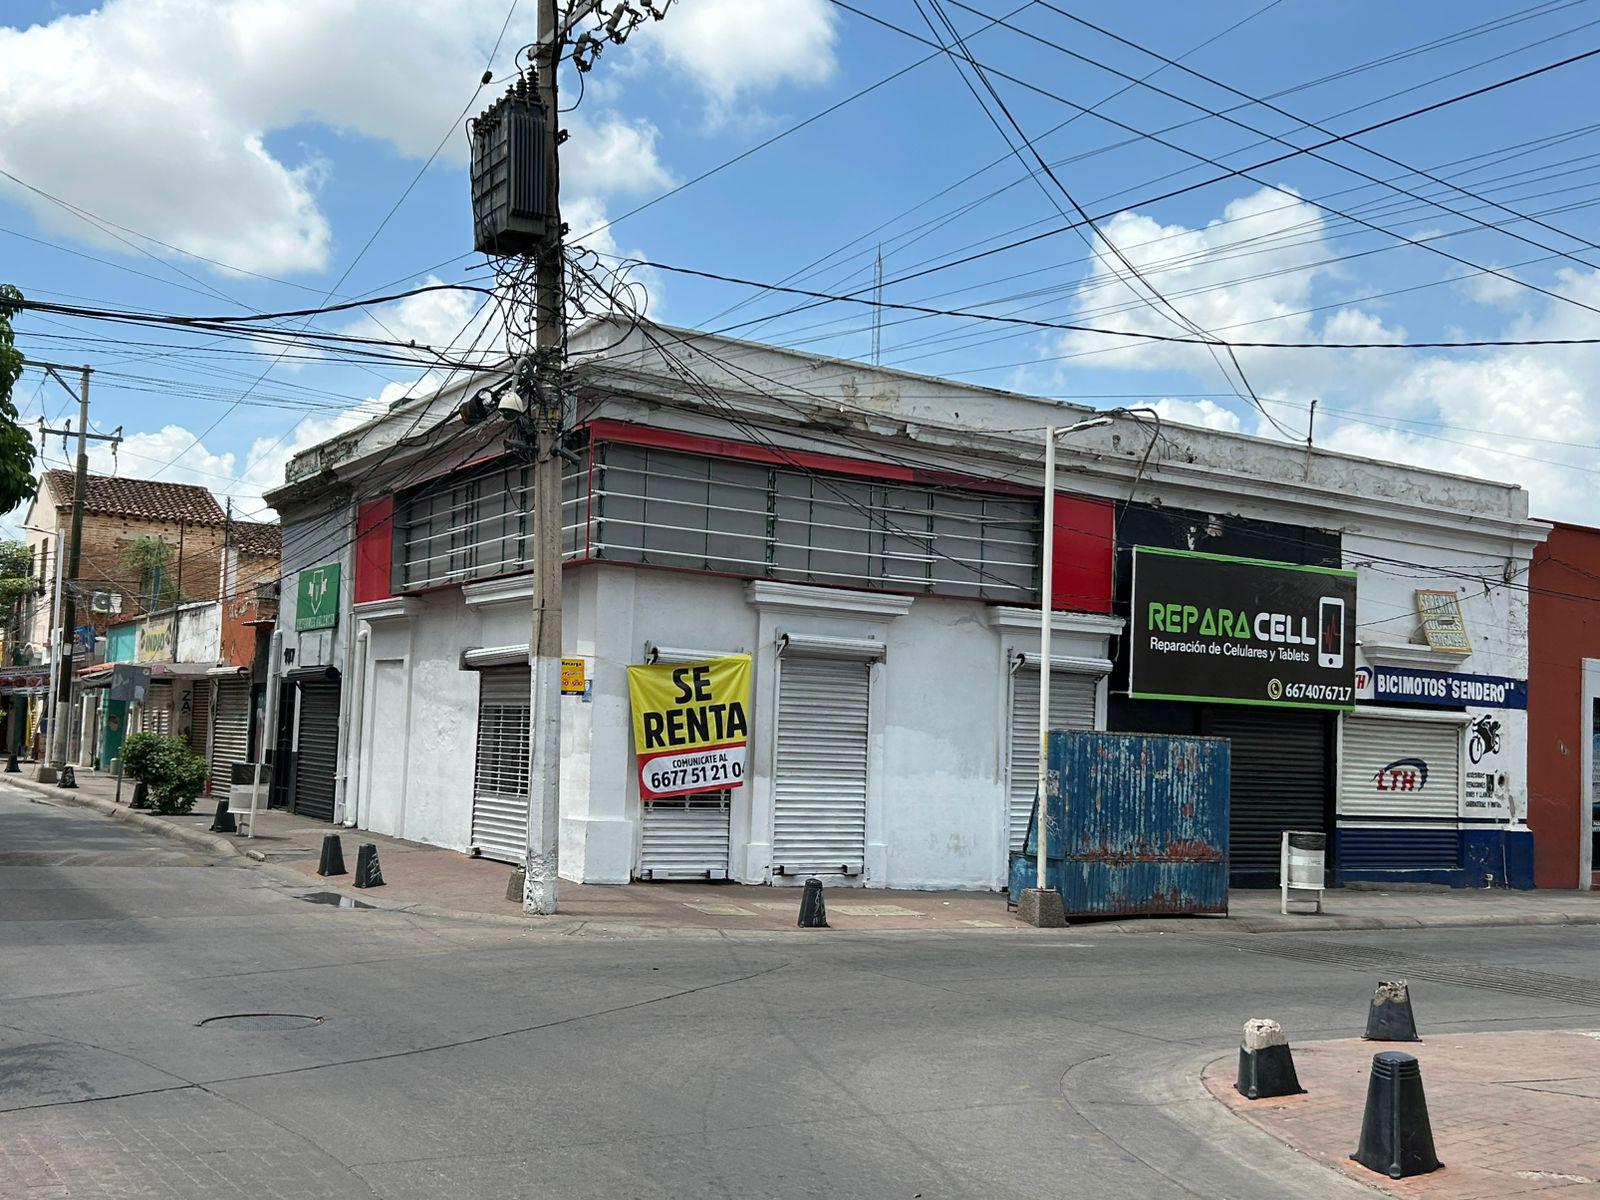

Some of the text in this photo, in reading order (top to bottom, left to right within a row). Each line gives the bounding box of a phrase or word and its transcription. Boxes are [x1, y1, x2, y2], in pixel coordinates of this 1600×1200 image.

[1148, 602, 1316, 645] REPARACELL
[1150, 637, 1310, 662] Reparación de Celulares y Tablets
[672, 666, 712, 704] SE
[1285, 683, 1351, 700] 6674076717
[1377, 674, 1446, 698] BICIMOTOS
[643, 702, 747, 748] RENTA
[672, 753, 728, 768] COMUNICATE AL
[651, 769, 687, 788] 6677
[691, 766, 707, 783] 51
[711, 763, 728, 781] 21
[1377, 768, 1416, 791] LTH
